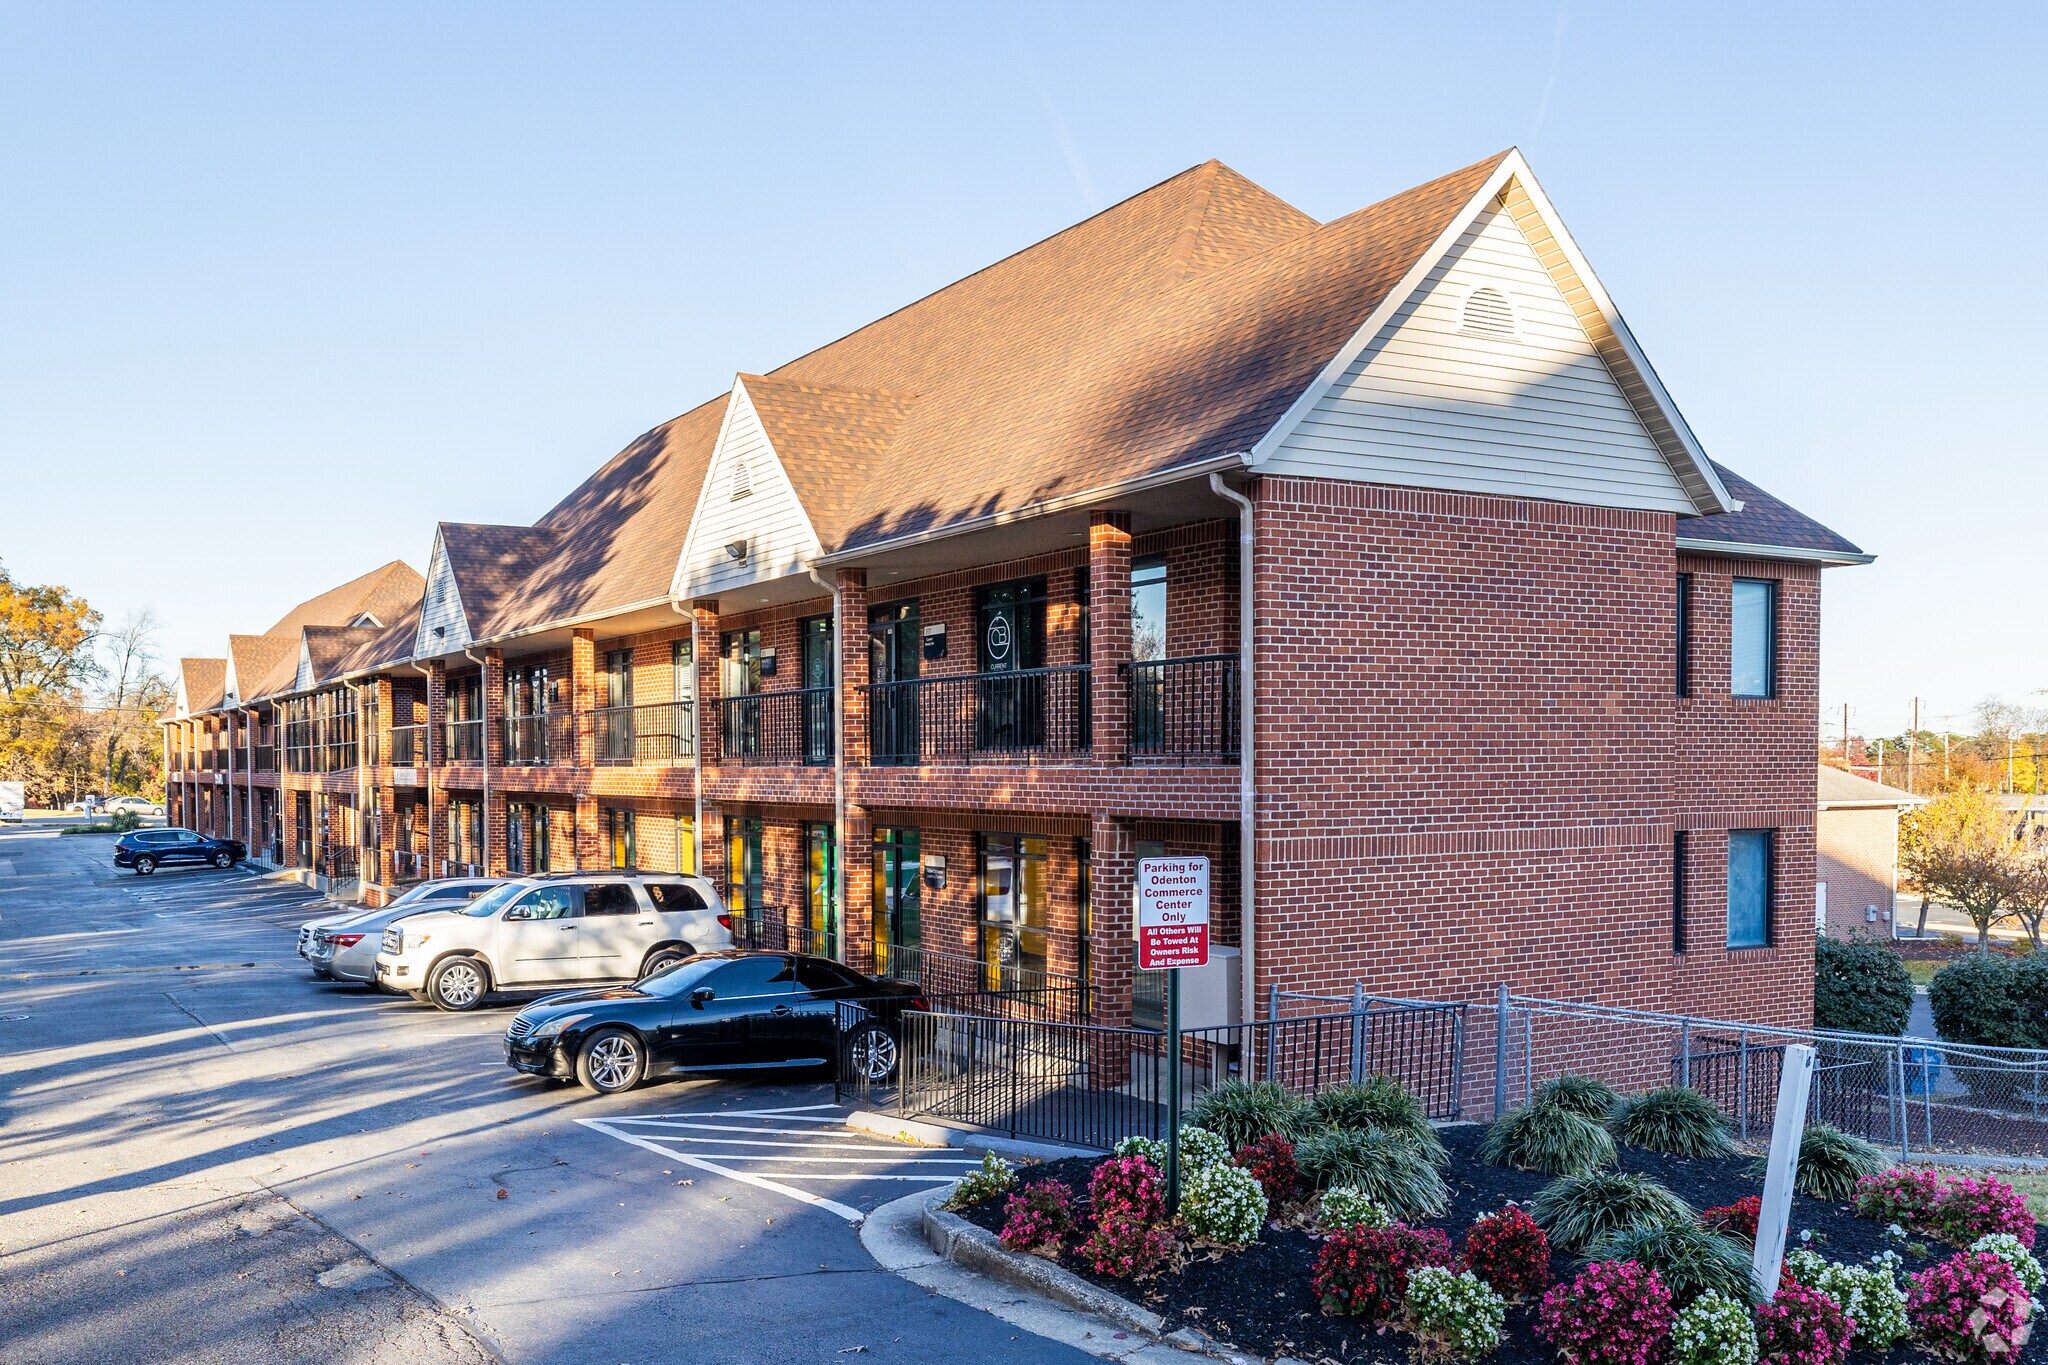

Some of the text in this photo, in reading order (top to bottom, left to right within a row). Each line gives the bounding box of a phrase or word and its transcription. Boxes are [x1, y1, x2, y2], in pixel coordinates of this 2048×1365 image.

[1144, 862, 1204, 873] Parking for
[1151, 876, 1196, 884] Odenton
[1145, 888, 1202, 898] Commerce
[1156, 901, 1192, 910] Center
[1162, 912, 1186, 922] Only
[1167, 958, 1200, 966] Expense
